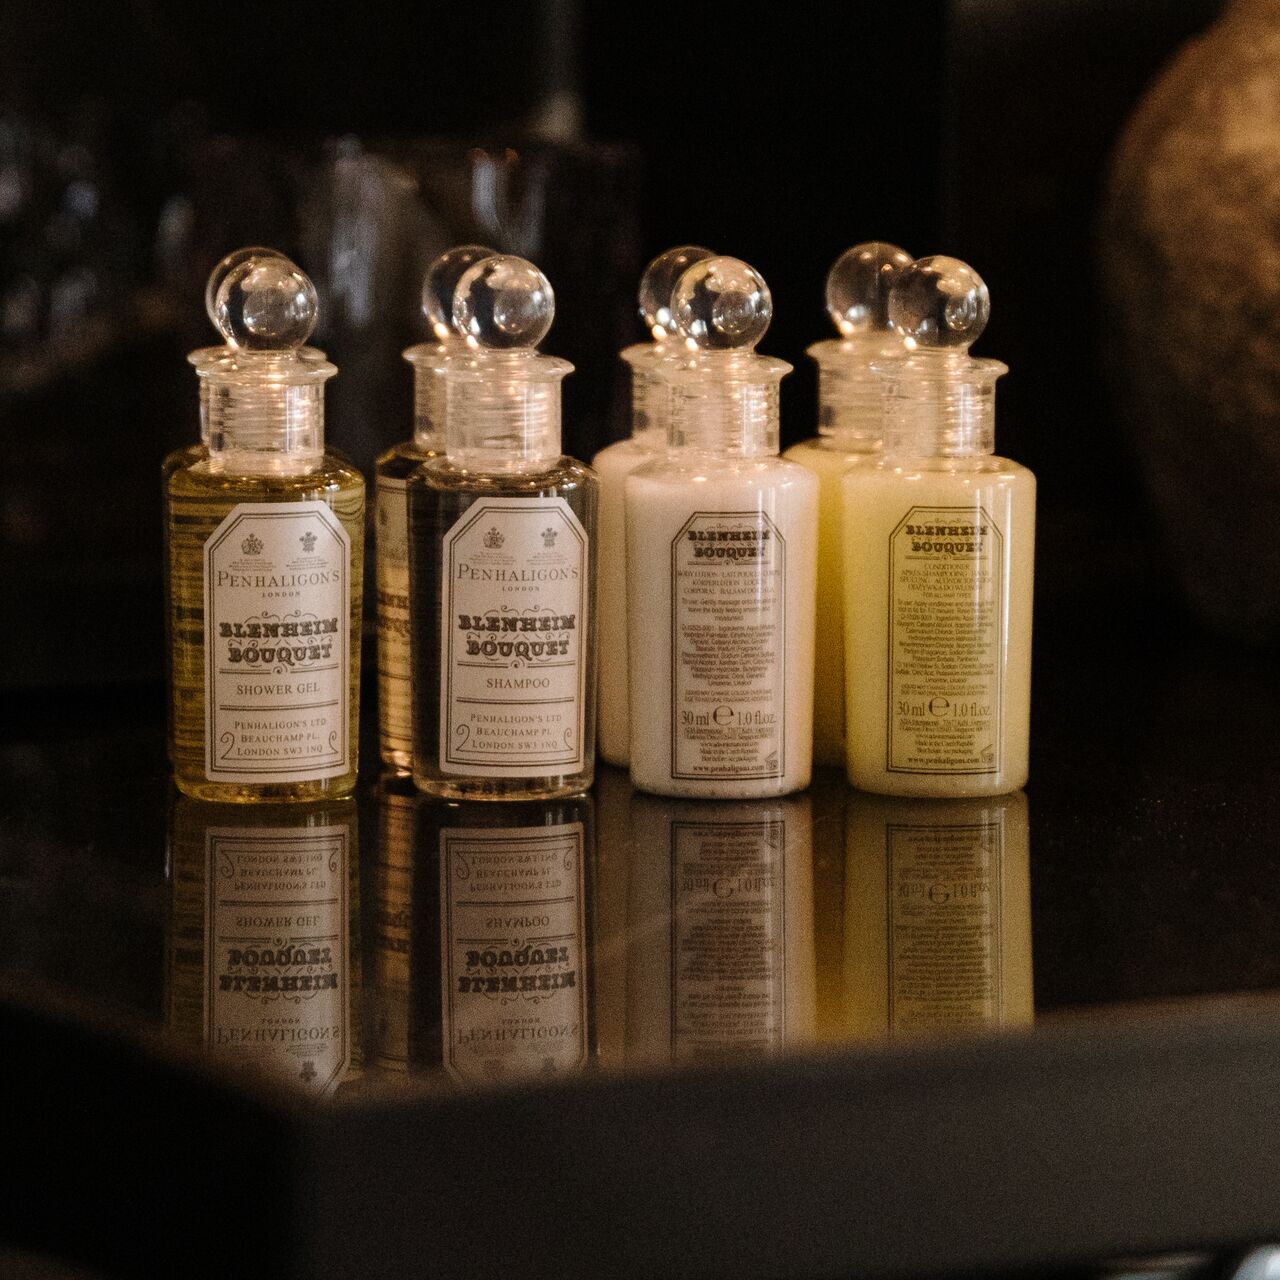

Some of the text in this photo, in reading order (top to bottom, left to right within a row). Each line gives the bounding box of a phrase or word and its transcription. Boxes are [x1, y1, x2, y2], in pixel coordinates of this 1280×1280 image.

[688, 530, 770, 541] BLENHEIM
[905, 525, 988, 536] BLENHEIM
[217, 568, 340, 588] PENHALIGON'S
[457, 563, 579, 581] PENHALIGON'S
[219, 618, 338, 638] BLENHEIM
[458, 614, 576, 632] BLENHEIM
[228, 643, 333, 666] BOUQUET
[466, 639, 569, 661] BOUQUET
[236, 682, 320, 695] SHOWER GEL
[486, 678, 550, 689] SHAMPOO
[897, 701, 910, 716] 30
[911, 702, 925, 717] ml
[953, 703, 969, 717] 1.0
[681, 710, 694, 726] 30
[695, 711, 710, 726] ml
[737, 711, 753, 726] 1.0
[241, 733, 304, 743] BEAUCHAMP
[476, 727, 539, 737] BEAUCHAMP
[237, 747, 280, 756] LONDON
[472, 740, 515, 750] LONDON
